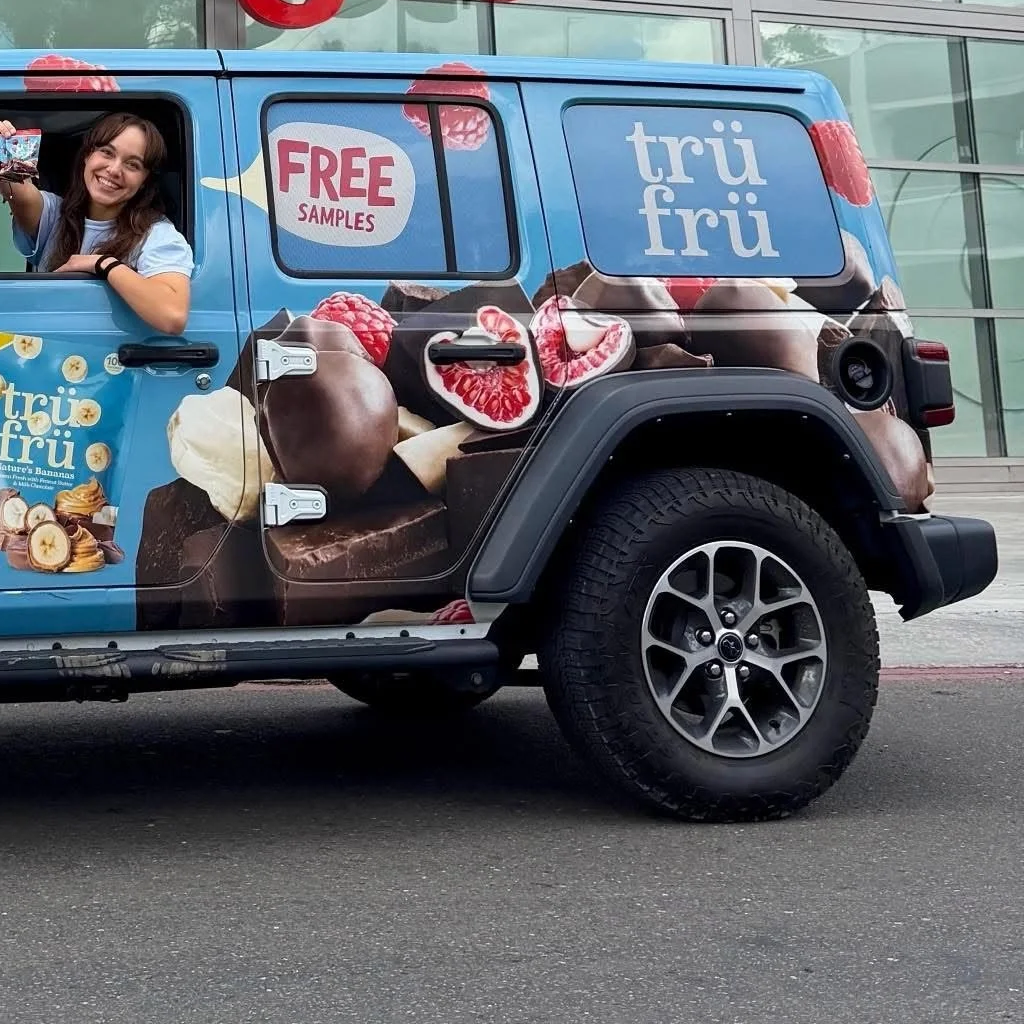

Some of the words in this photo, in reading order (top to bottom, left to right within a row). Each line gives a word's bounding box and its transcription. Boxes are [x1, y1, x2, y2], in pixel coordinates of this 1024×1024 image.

[277, 138, 396, 206] FREE
[625, 119, 768, 185] trü
[297, 202, 376, 232] SAMPLES
[638, 184, 781, 258] frü
[2, 381, 82, 428] trü
[35, 467, 75, 480] Bananas
